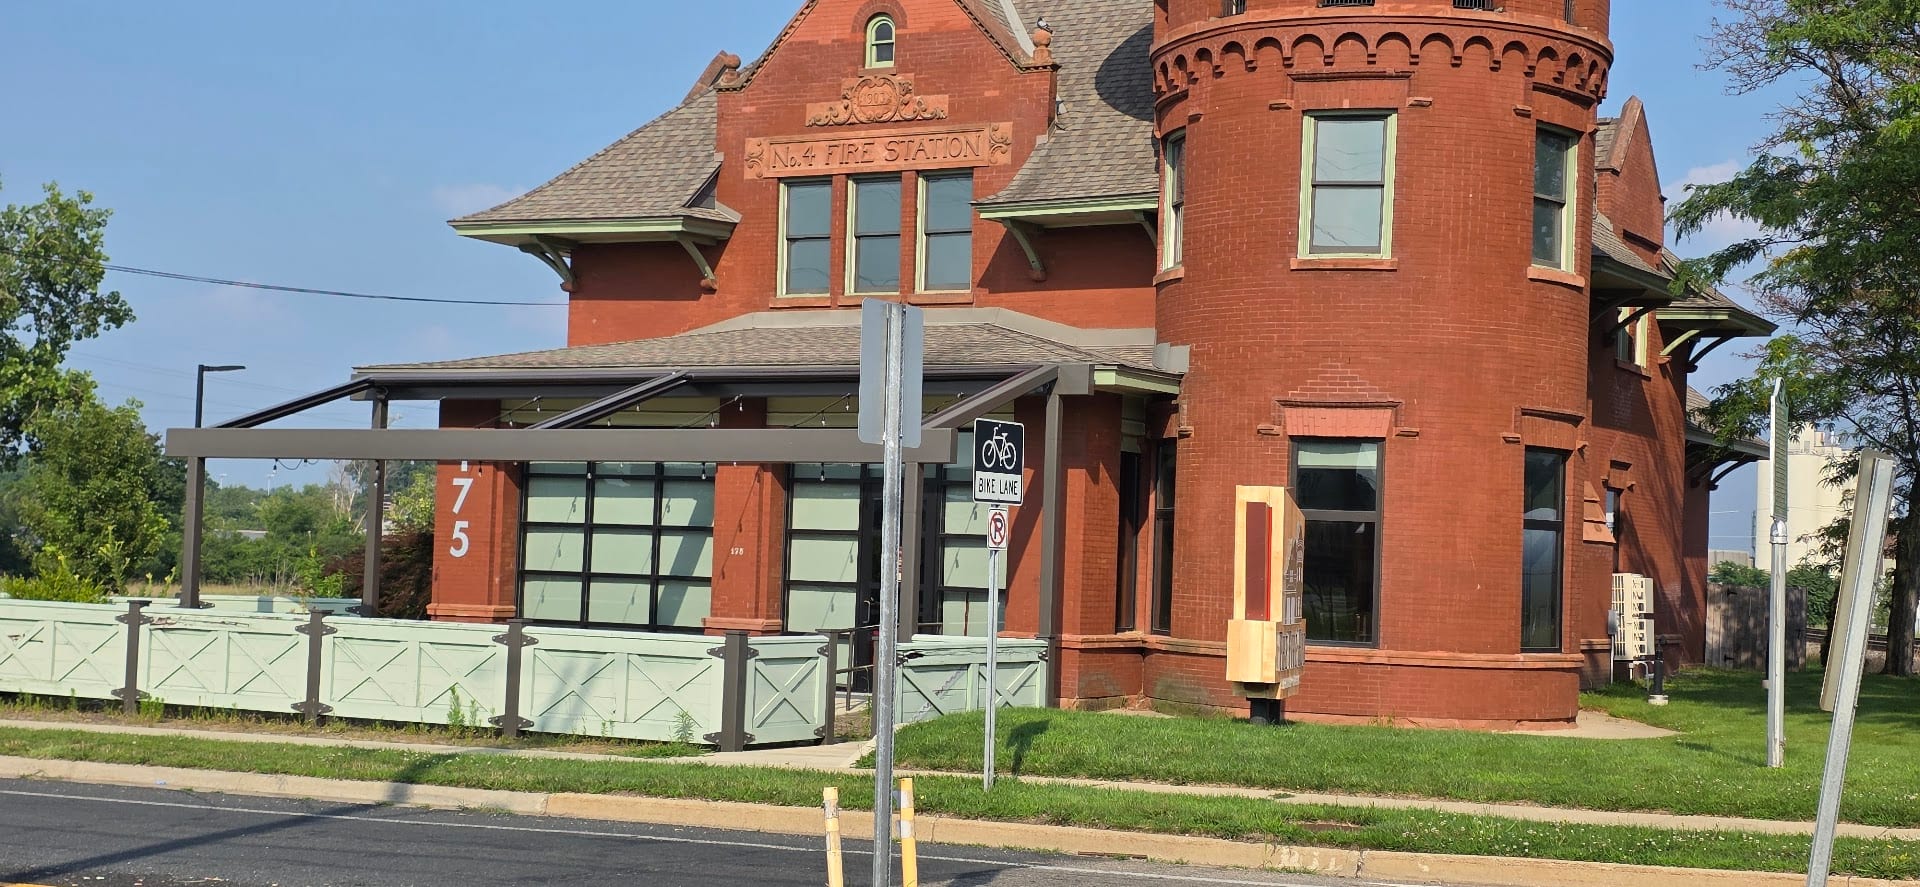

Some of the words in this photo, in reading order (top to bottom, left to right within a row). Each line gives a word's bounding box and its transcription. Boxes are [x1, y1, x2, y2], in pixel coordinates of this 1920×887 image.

[825, 142, 875, 166] FIRE
[884, 134, 981, 161] STATION
[979, 478, 996, 494] BIKE
[1000, 480, 1018, 496] LANE
